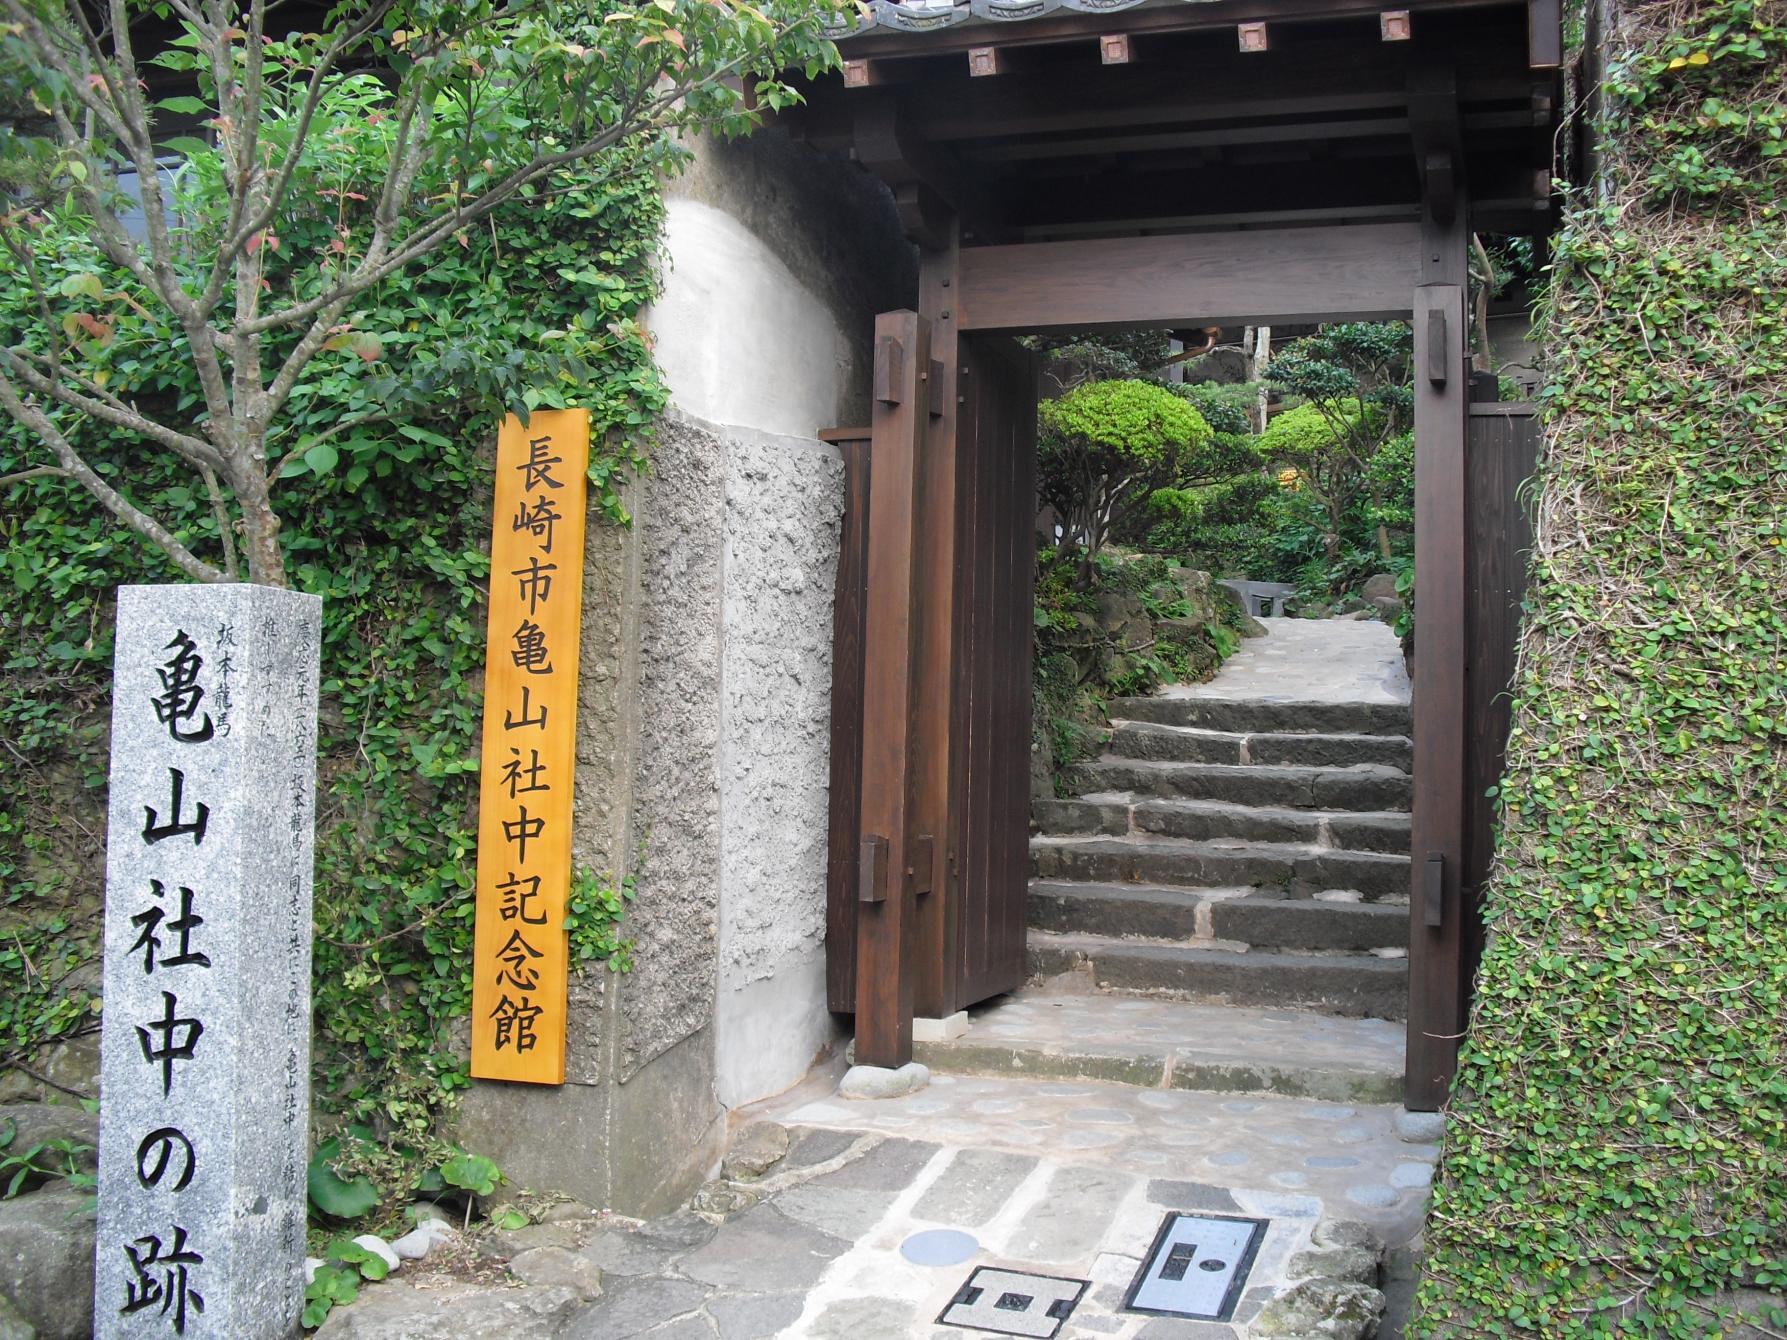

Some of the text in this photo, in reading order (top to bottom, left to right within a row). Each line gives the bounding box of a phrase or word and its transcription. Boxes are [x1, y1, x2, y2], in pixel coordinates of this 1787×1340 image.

[120, 629, 214, 1336] 亀山社中の跡
[212, 622, 239, 738] 坂本龍馬
[489, 437, 563, 1055] 長崎市亀山社中記念館
